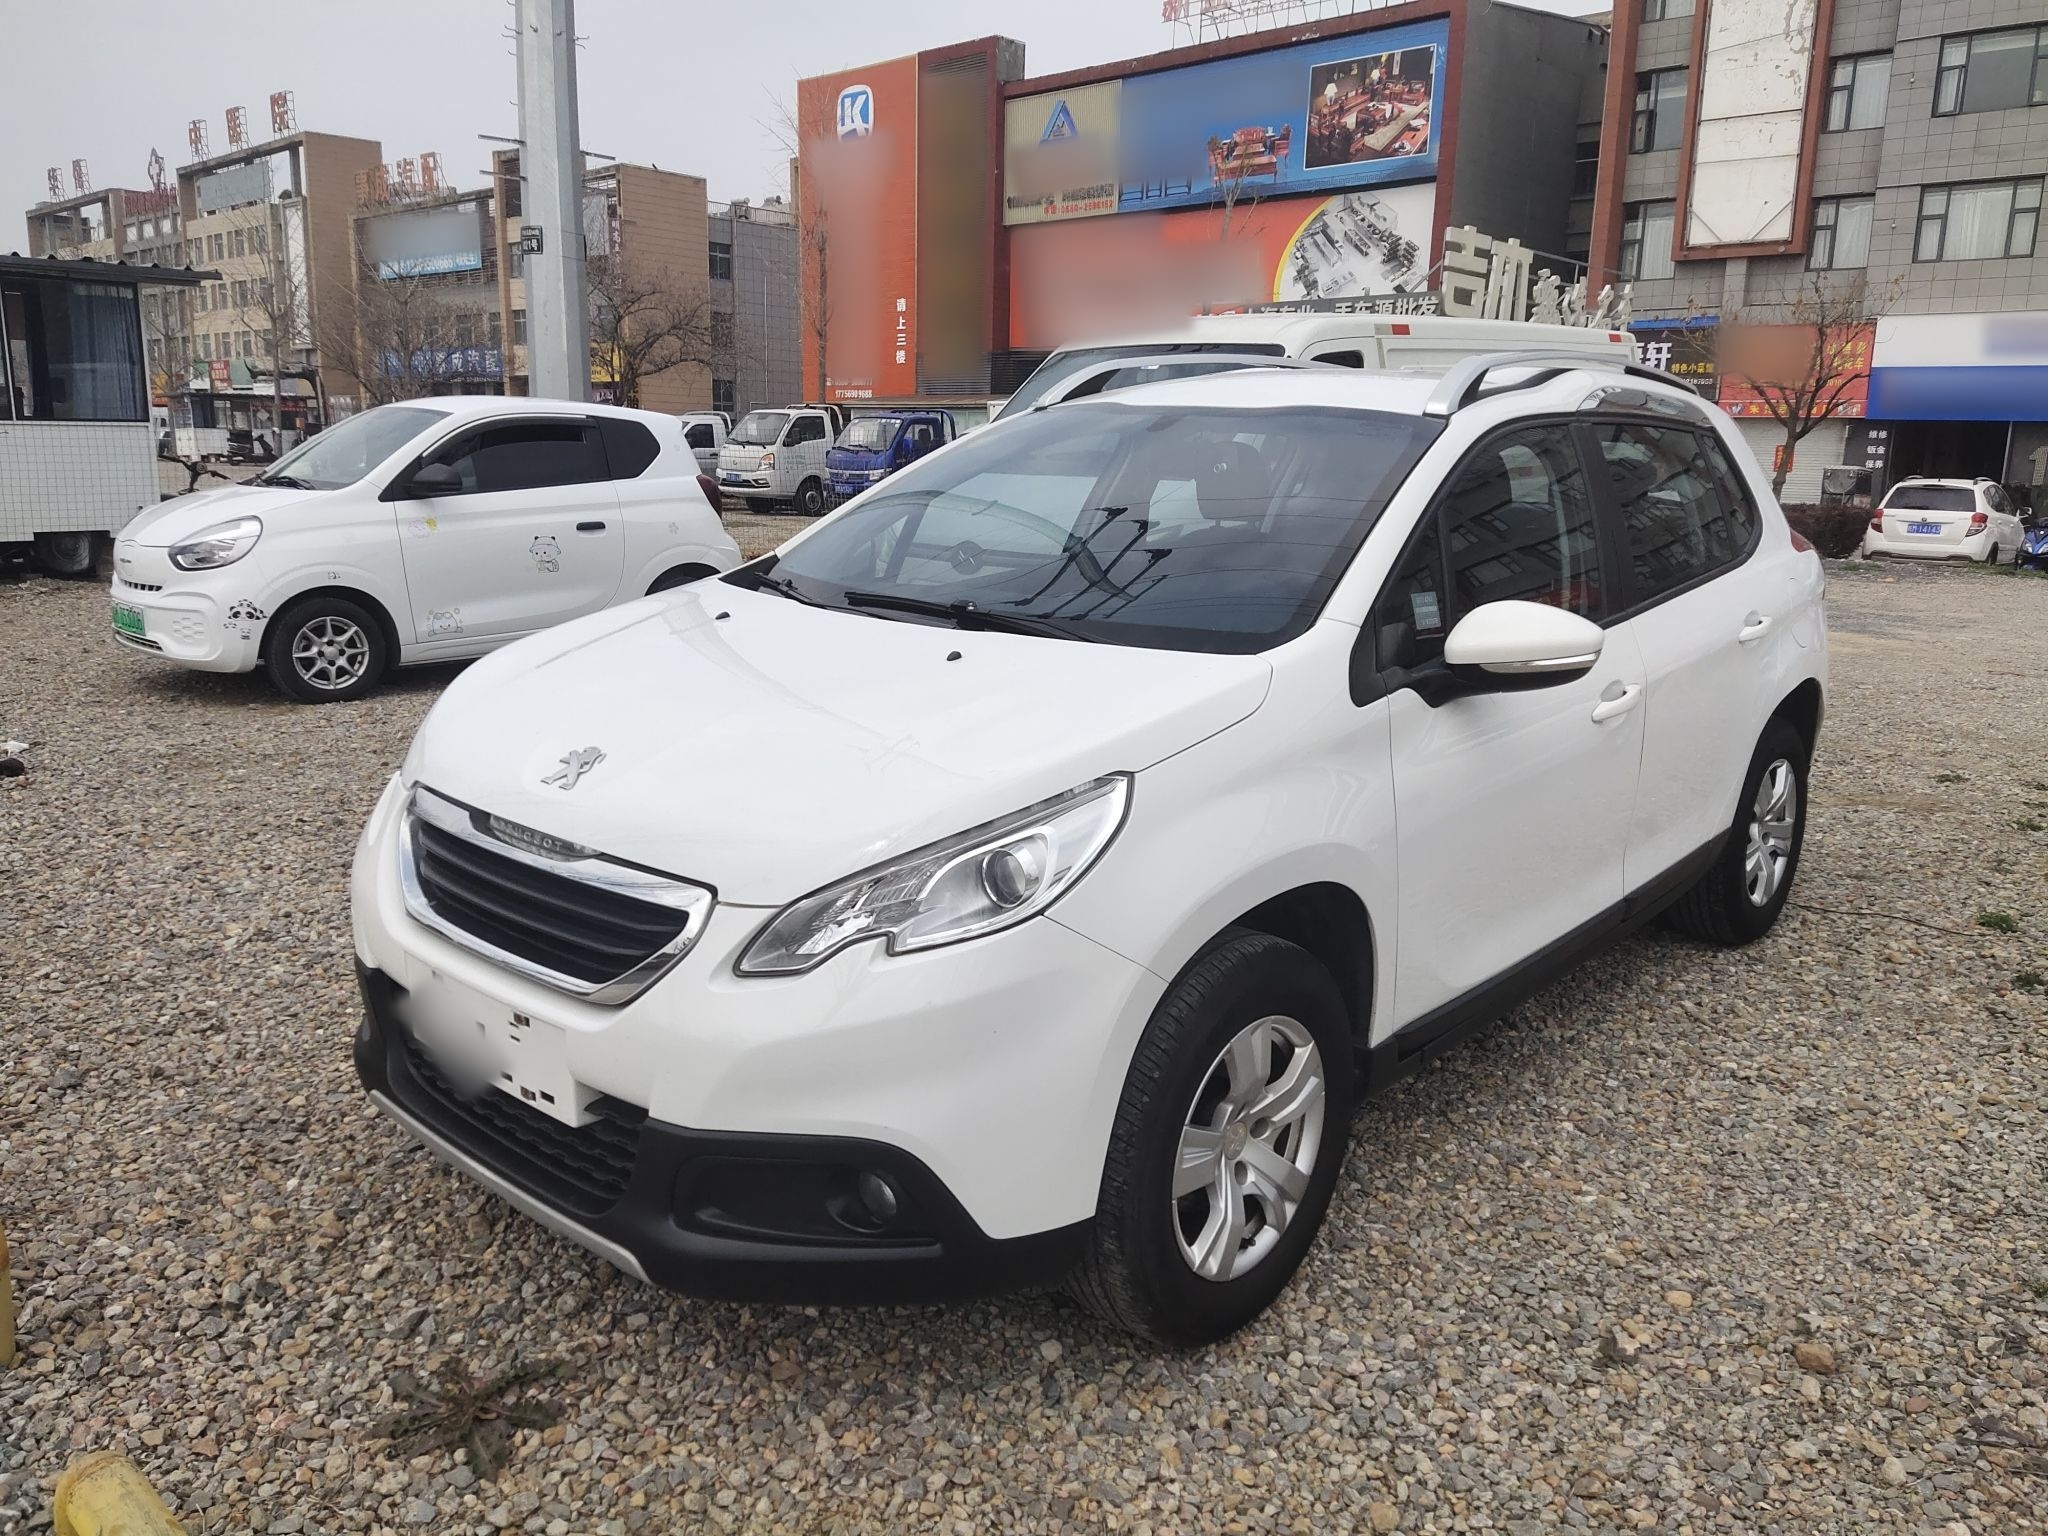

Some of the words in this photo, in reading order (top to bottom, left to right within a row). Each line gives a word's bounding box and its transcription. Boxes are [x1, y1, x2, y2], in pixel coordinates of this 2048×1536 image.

[896, 298, 906, 364] 请上三楼
[1868, 430, 1888, 439] 维修
[1866, 445, 1886, 454] 钣金
[1865, 459, 1884, 469] 保养
